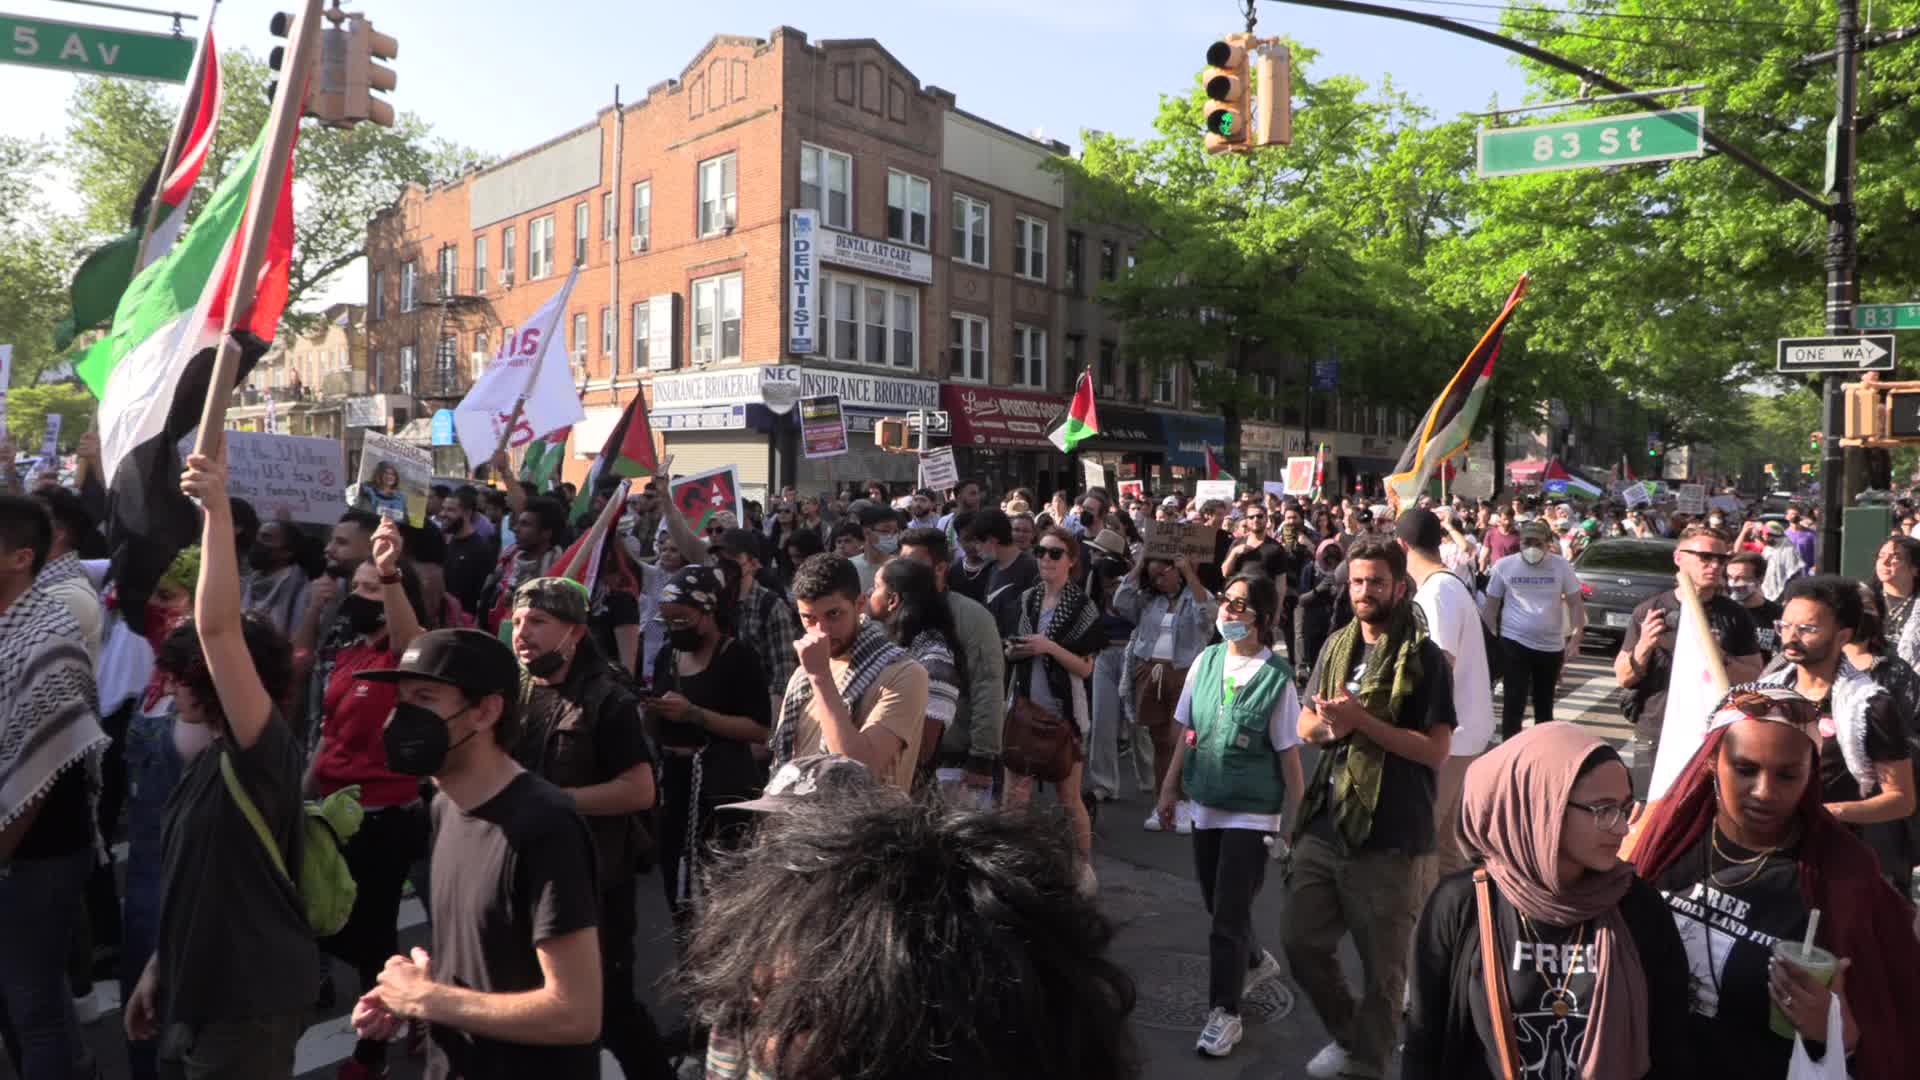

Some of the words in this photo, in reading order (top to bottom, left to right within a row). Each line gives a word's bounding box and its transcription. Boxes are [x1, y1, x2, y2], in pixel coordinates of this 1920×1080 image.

[14, 26, 39, 56] 5
[1532, 131, 1581, 162] 83
[1599, 125, 1644, 155] St
[836, 235, 870, 254] DENTAL
[873, 243, 890, 258] ART
[890, 246, 912, 263] CARE
[793, 239, 811, 337] DENTIST
[1864, 308, 1893, 327] 83
[1795, 348, 1825, 361] ONE
[1842, 347, 1875, 360] WAY
[654, 376, 703, 403] INSURANCE
[704, 371, 761, 400] BROKERAG
[764, 367, 797, 382] NEC
[802, 373, 871, 402] INSURANCE
[874, 379, 937, 408] BROKERAGE
[1670, 896, 1707, 919] HOLY
[1710, 912, 1748, 937] LAND
[1750, 930, 1777, 947] FIV
